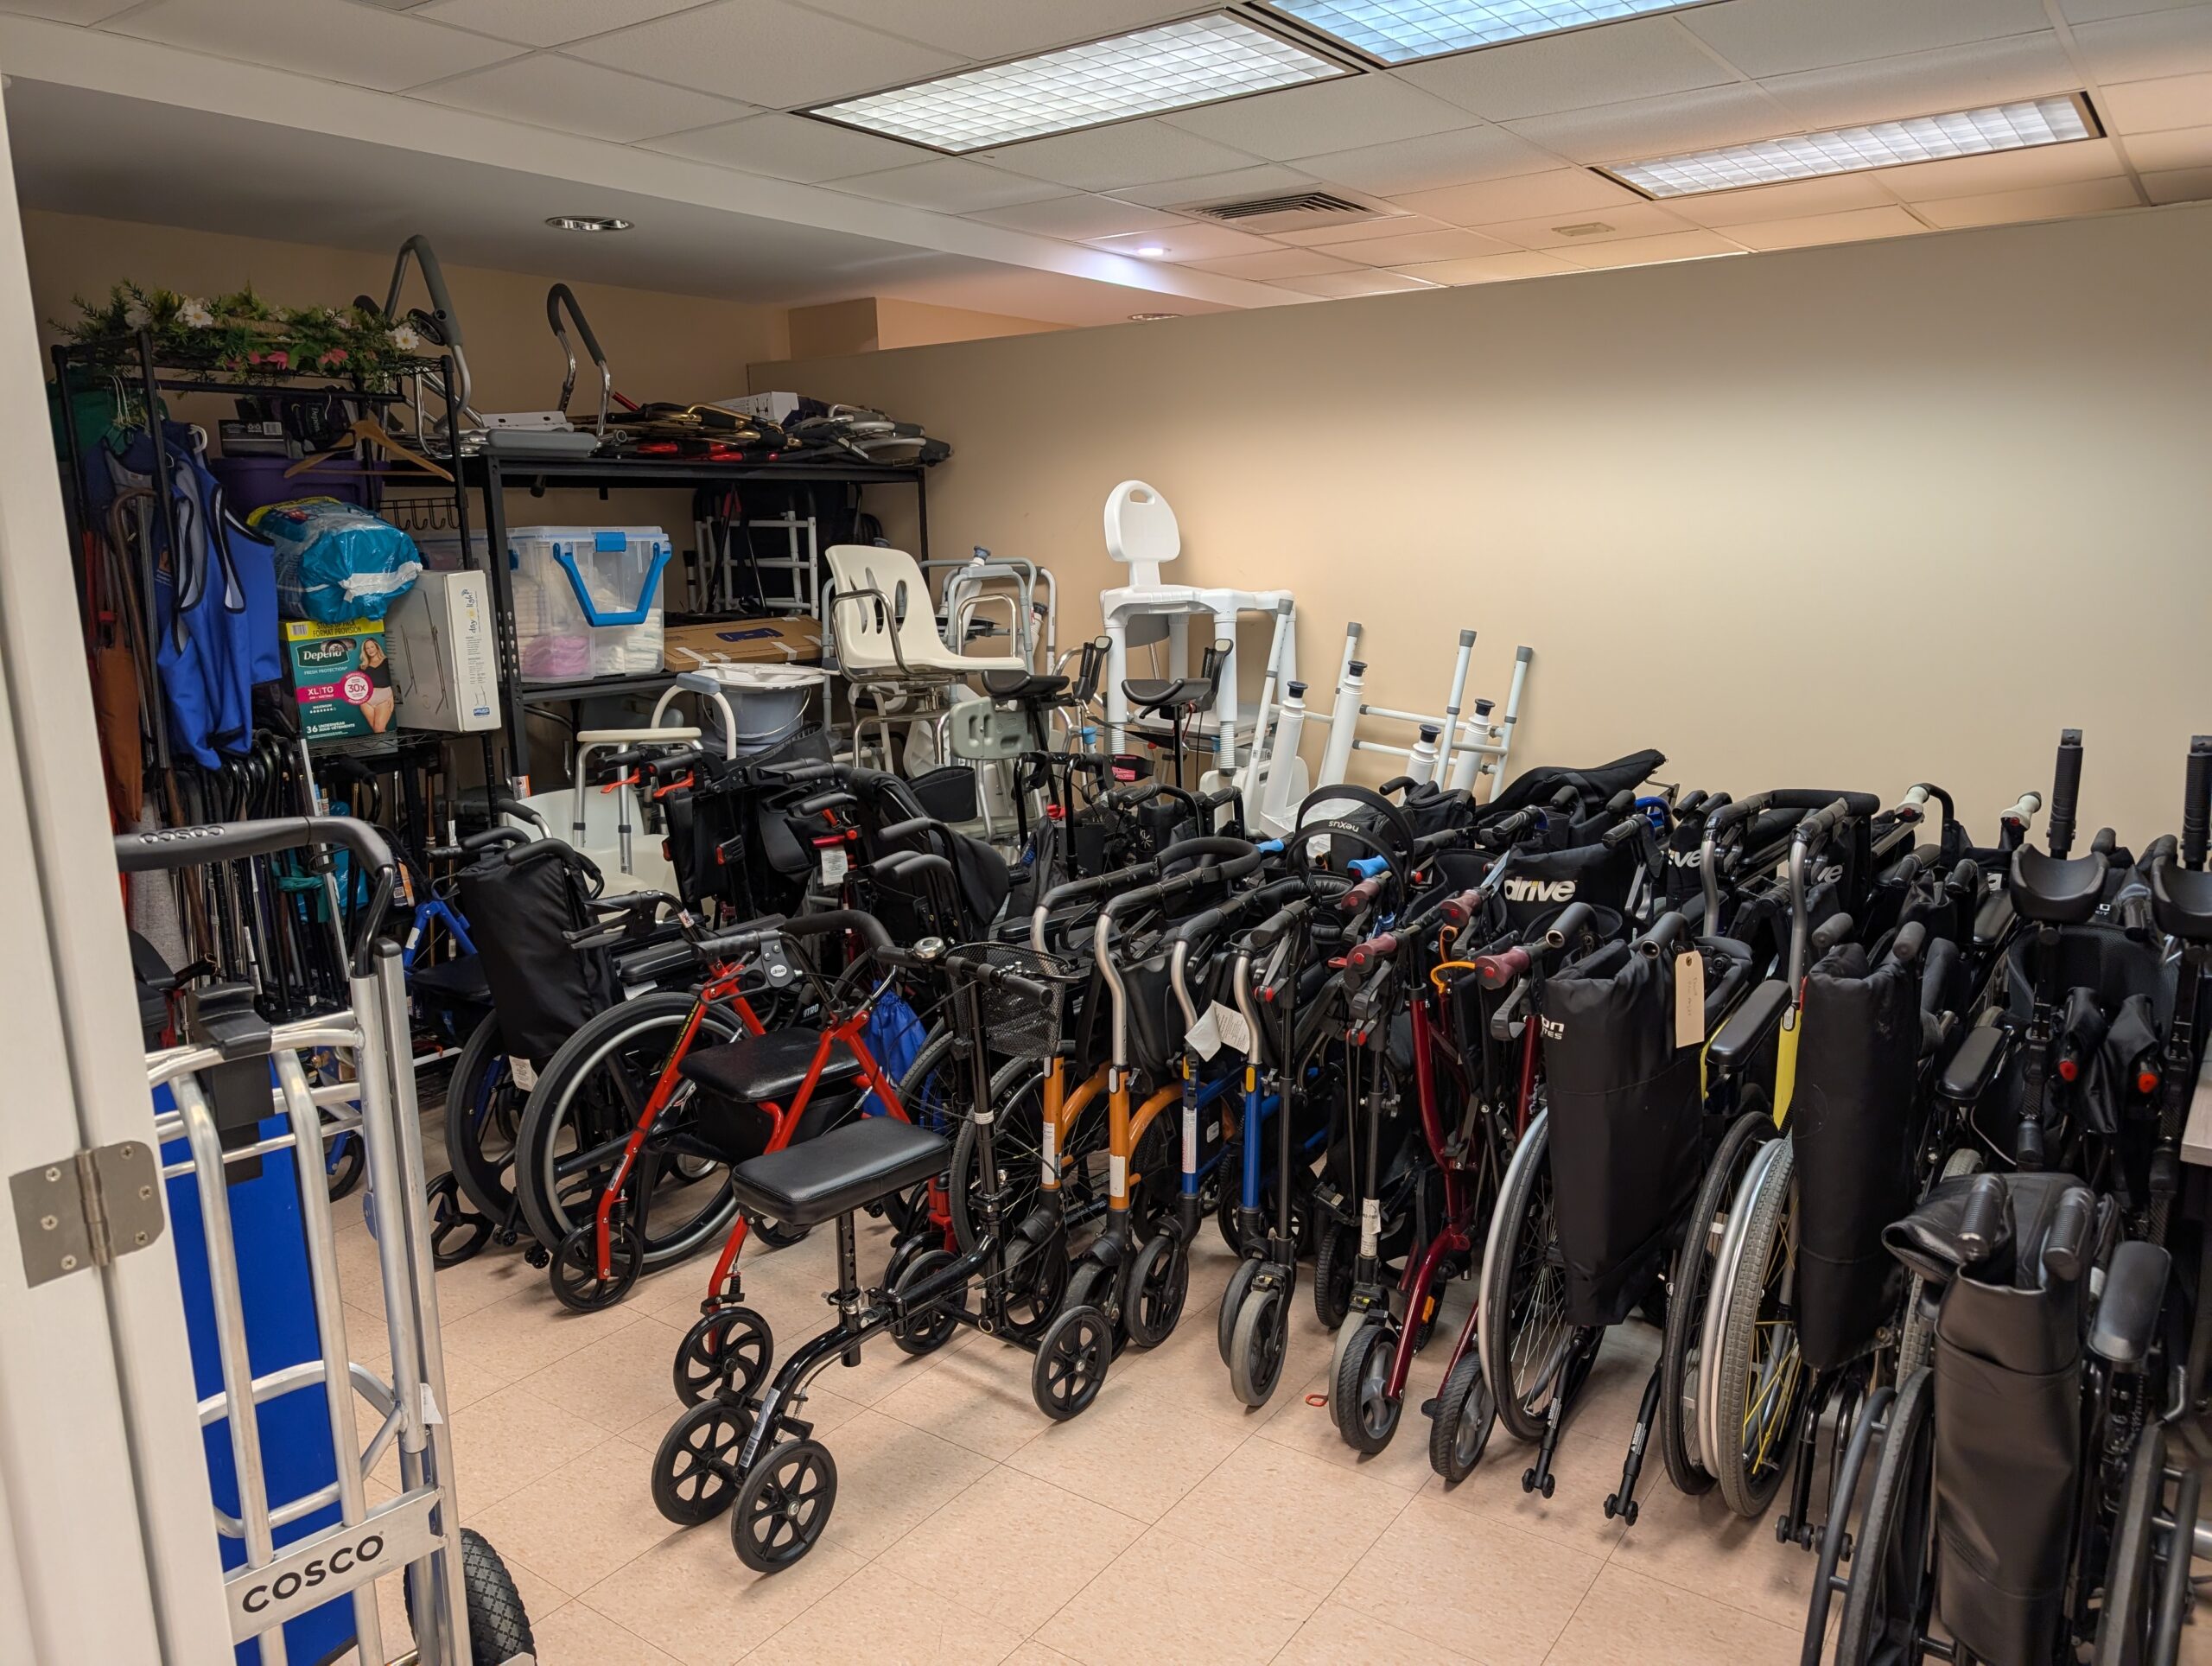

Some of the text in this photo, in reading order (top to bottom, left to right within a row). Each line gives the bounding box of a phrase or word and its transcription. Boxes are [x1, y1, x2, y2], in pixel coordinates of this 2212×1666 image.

[313, 626, 361, 637] FORMAT PROVISION
[468, 620, 478, 633] day
[347, 684, 366, 693] 30x
[306, 725, 319, 734] 36
[138, 825, 226, 843] COSCO
[1503, 876, 1576, 902] drive
[242, 1535, 384, 1613] COSCO
